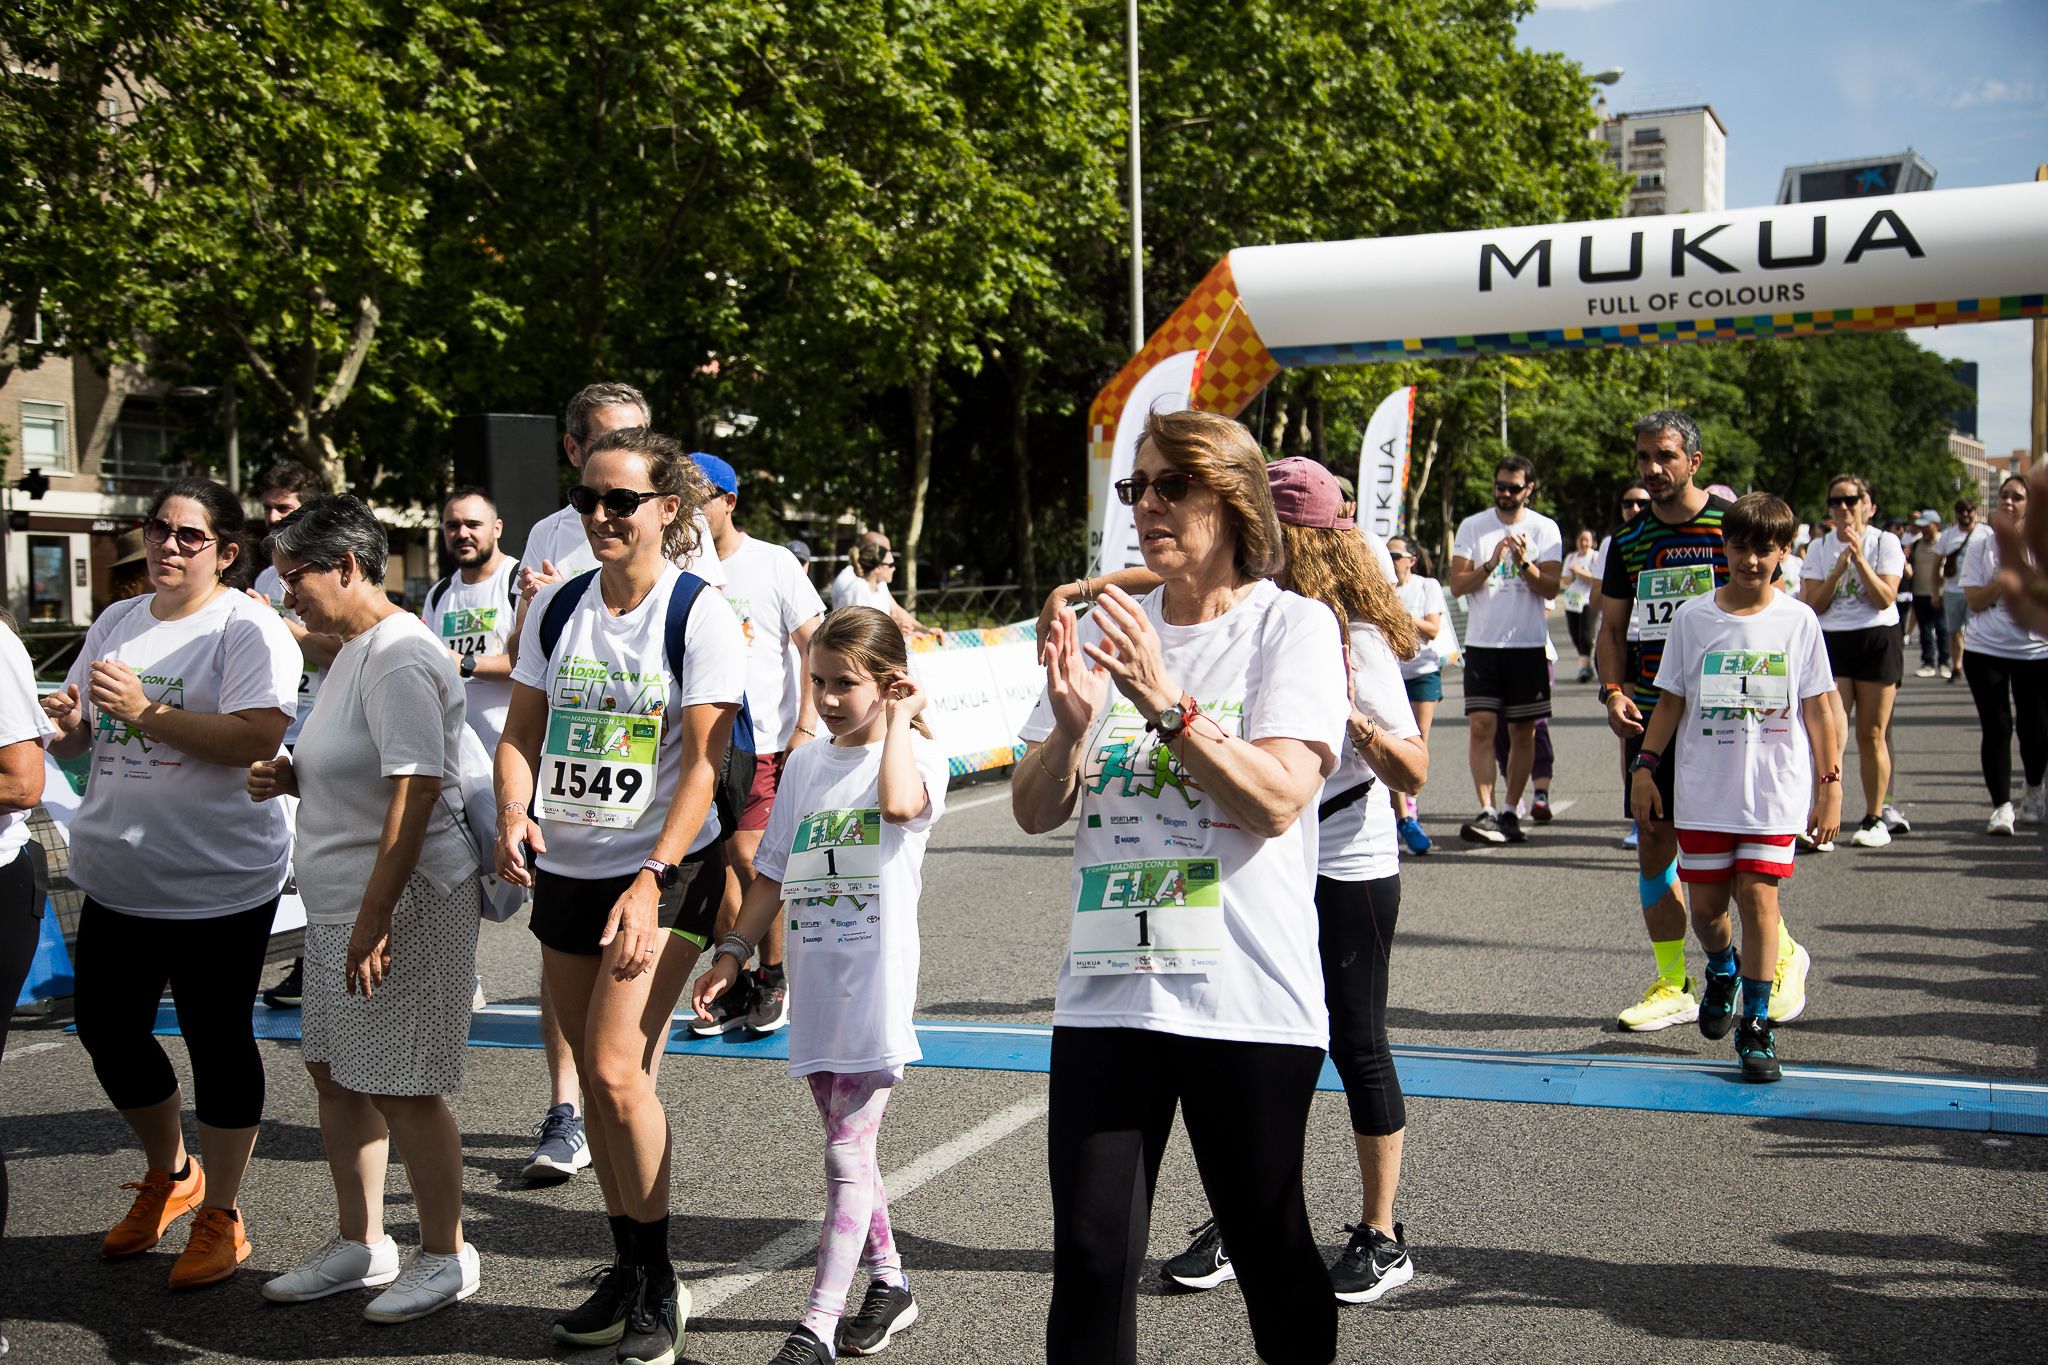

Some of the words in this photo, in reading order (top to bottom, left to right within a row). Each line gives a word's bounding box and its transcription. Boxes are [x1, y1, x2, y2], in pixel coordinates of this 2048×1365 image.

[1479, 209, 1926, 291] MUKUA
[1588, 294, 1640, 316] FULL
[1648, 292, 1679, 312] OF
[1688, 282, 1805, 310] COLOURS
[1375, 438, 1396, 537] UKUA
[1666, 547, 1713, 560] XXXVIII
[1651, 575, 1696, 596] ELA
[1646, 600, 1686, 625] 12
[454, 614, 483, 634] ELA
[449, 635, 487, 656] 1124
[558, 665, 608, 679] MADRID
[611, 671, 641, 683] CON
[642, 673, 662, 683] LA
[1720, 655, 1769, 675] ELA
[142, 675, 167, 686] CON
[167, 678, 184, 688] LA
[1740, 676, 1748, 694] 1
[570, 715, 598, 724] MADRID
[566, 722, 630, 757] ELA
[550, 761, 643, 804] 1549
[1163, 816, 1187, 827] Biogen
[807, 817, 864, 850] ELA
[824, 849, 838, 876] 1
[1110, 862, 1143, 871] MADRID
[1145, 861, 1164, 869] CON
[1167, 860, 1179, 868] LA
[1102, 869, 1187, 908] ELA
[836, 920, 857, 928] Biogen
[1135, 910, 1151, 947] 1
